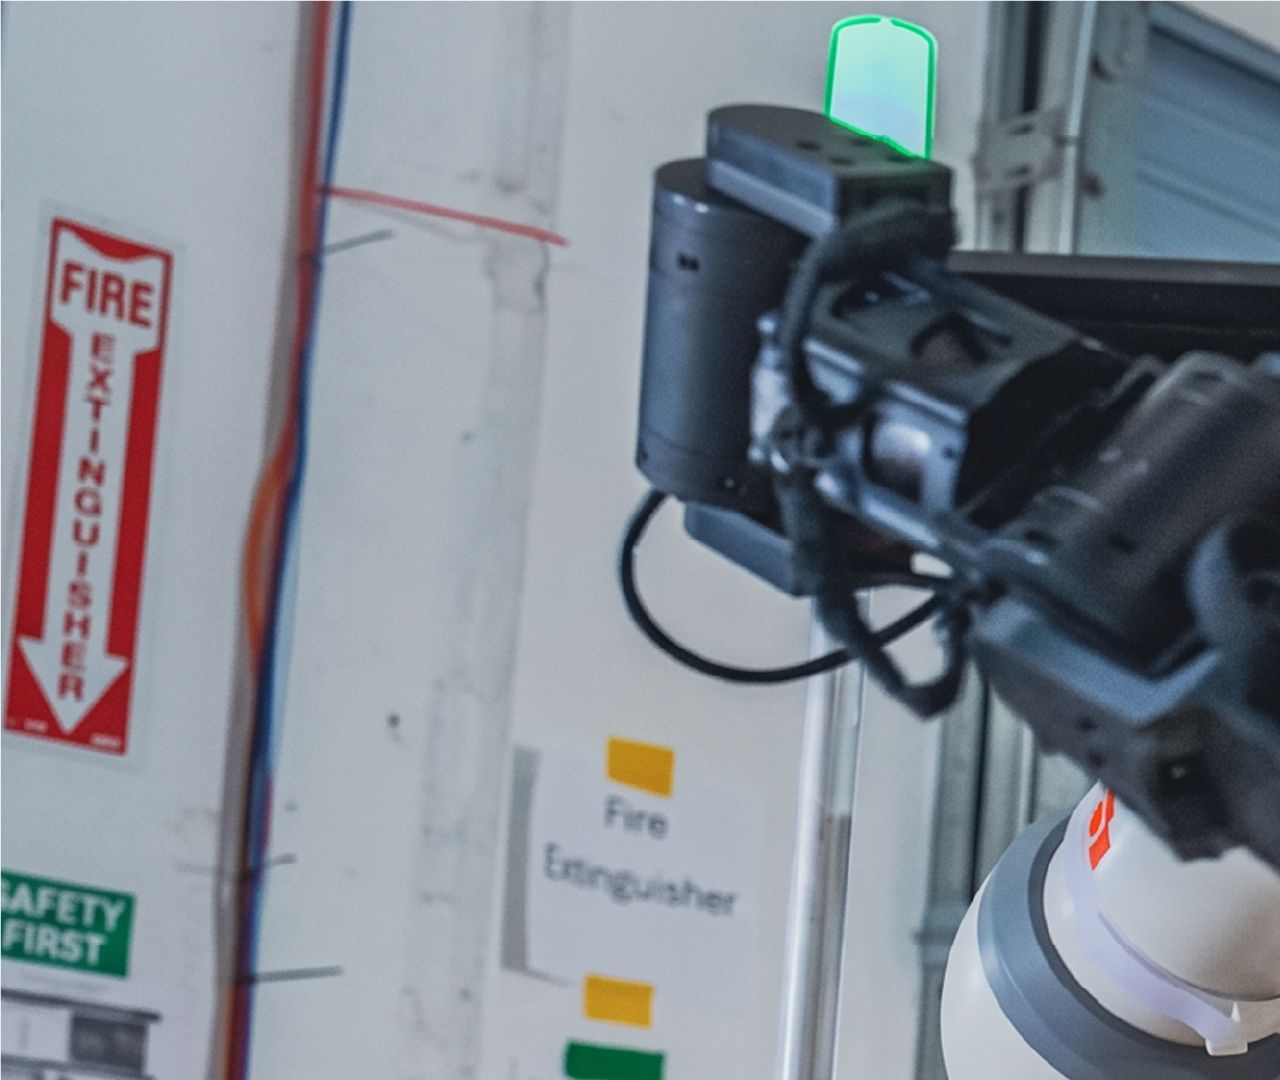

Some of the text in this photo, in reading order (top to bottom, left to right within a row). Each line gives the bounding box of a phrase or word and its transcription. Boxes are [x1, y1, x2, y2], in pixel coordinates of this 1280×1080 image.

[60, 260, 154, 329] FIRE
[57, 331, 115, 702] EXTINGUISHER
[604, 794, 670, 839] Fire
[544, 842, 738, 917] Extinguisher
[2, 919, 108, 966] FIRST
